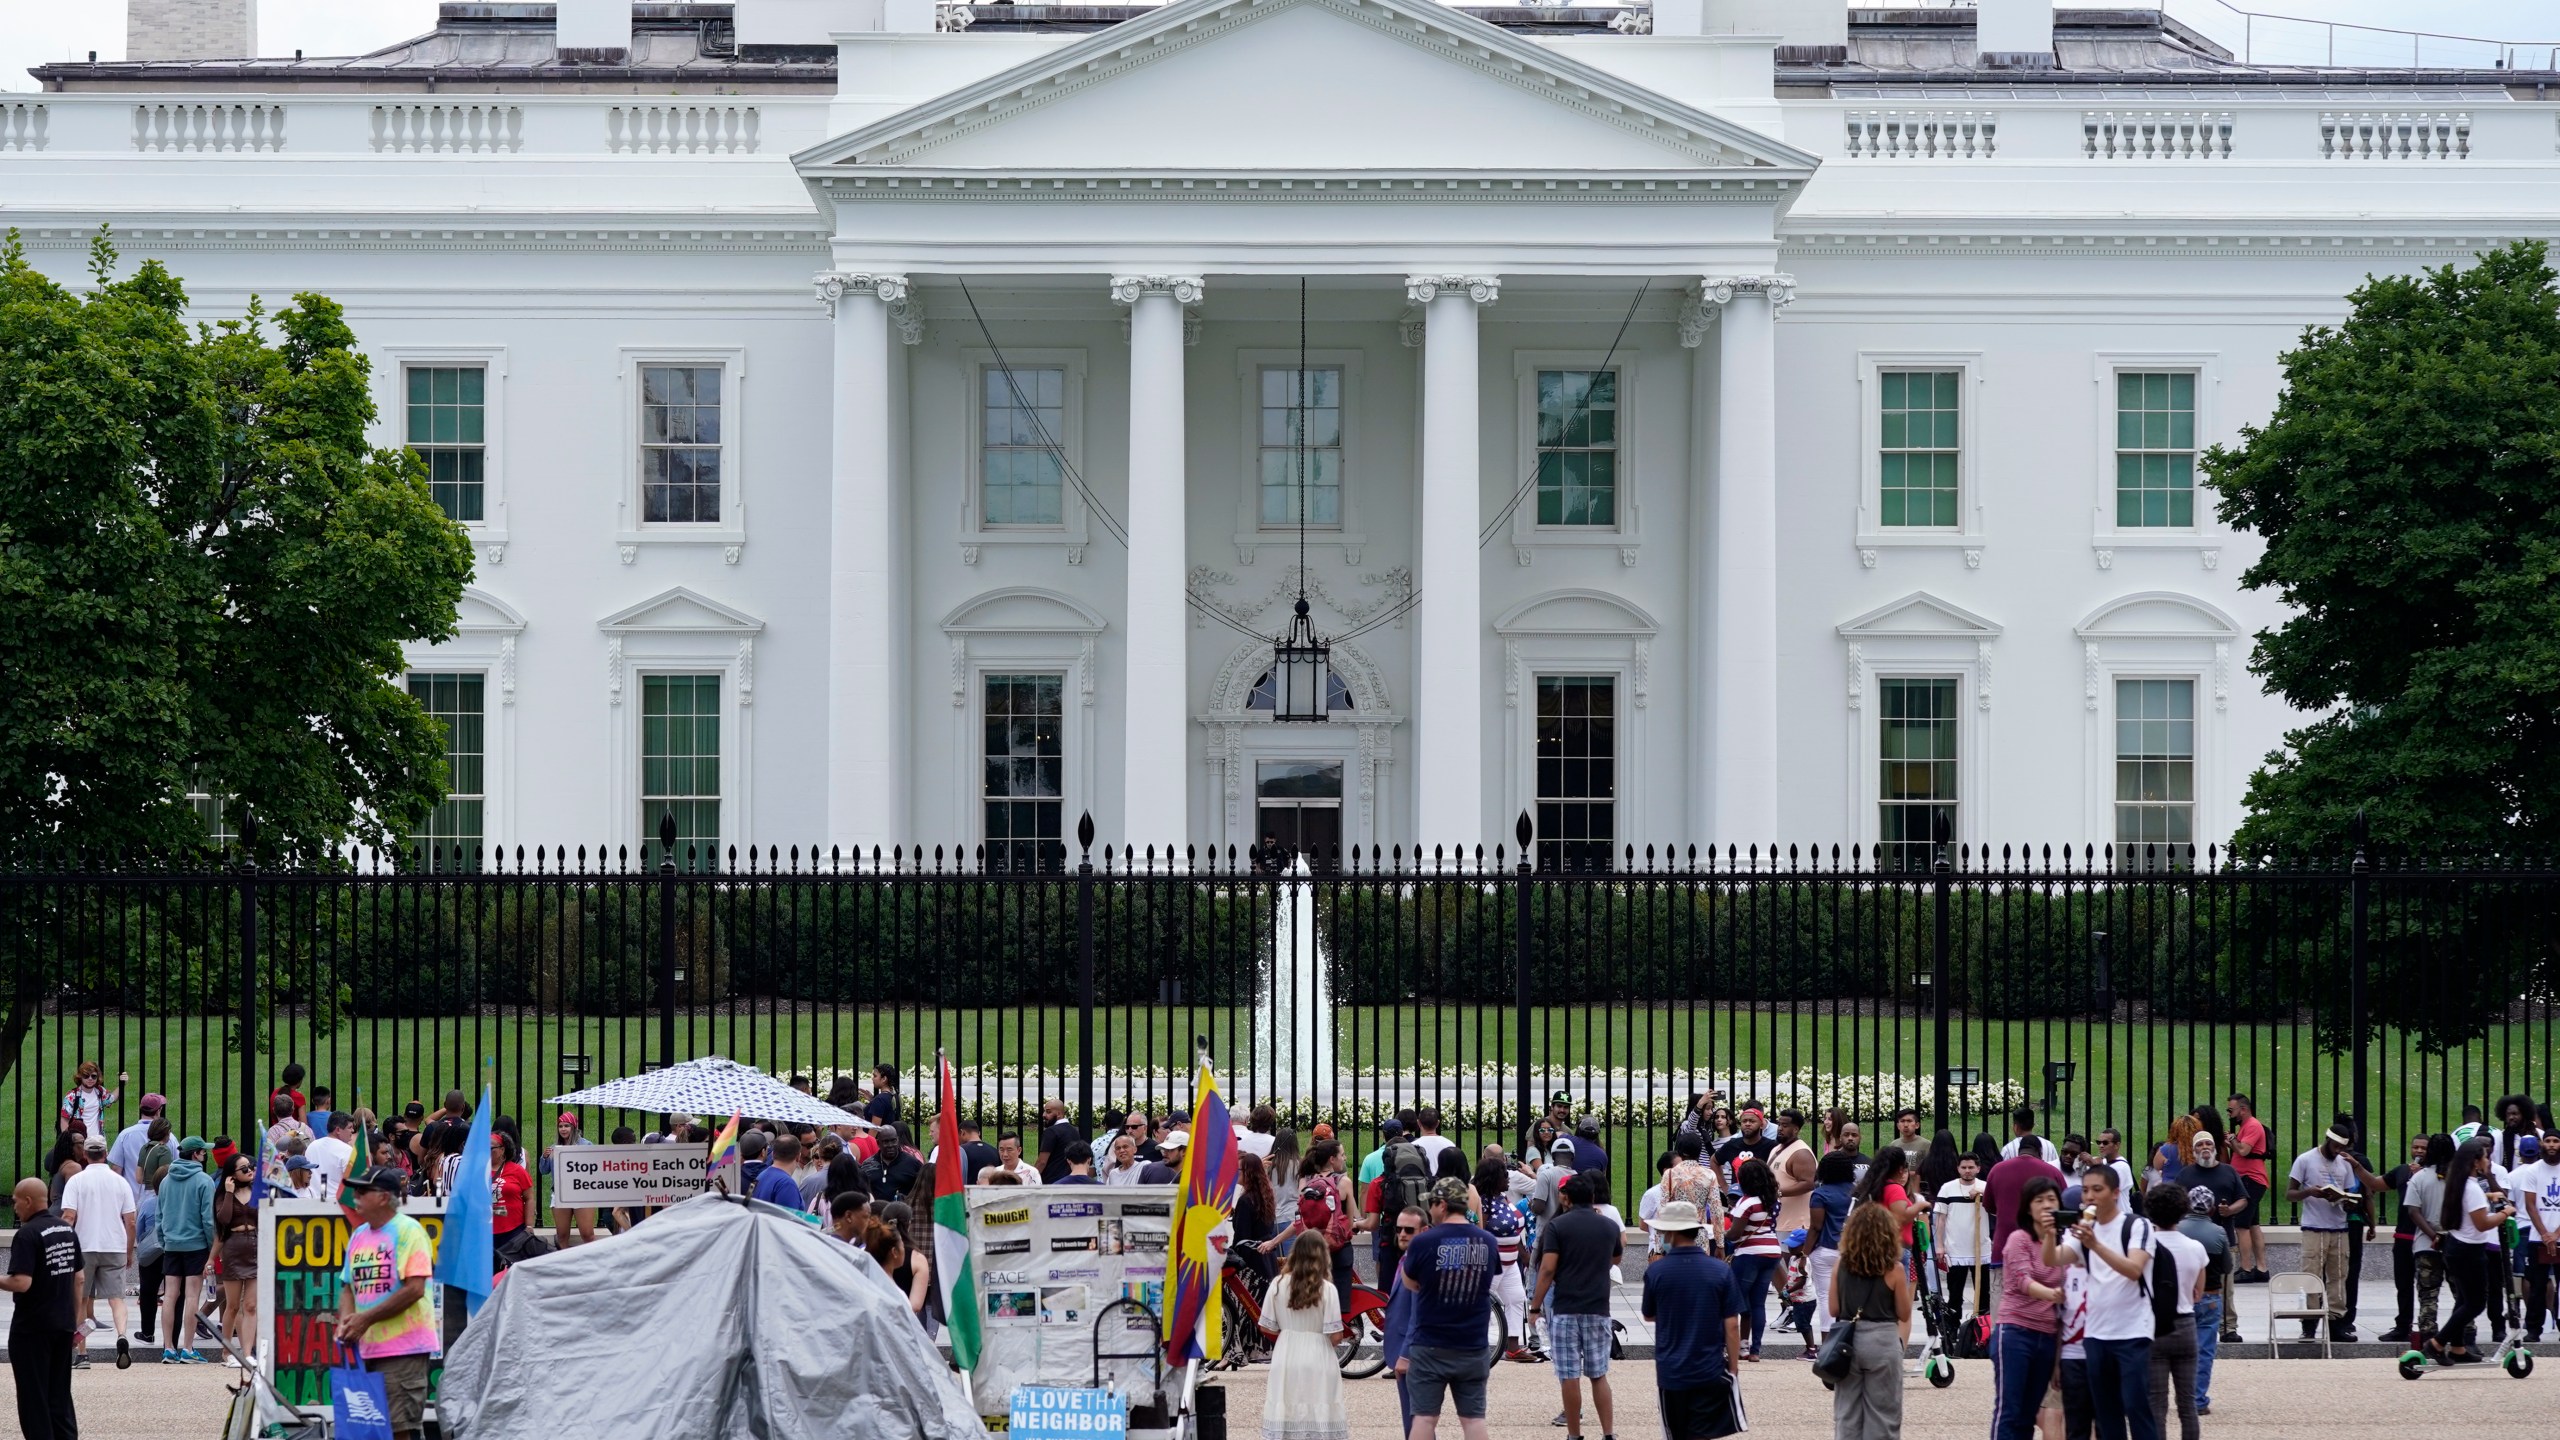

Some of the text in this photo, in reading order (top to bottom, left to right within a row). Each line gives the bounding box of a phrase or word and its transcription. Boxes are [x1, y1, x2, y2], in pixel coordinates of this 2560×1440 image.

[566, 1161, 598, 1175] Stop
[602, 1159, 648, 1174] Hating
[653, 1159, 684, 1171] Each
[573, 1176, 716, 1190] Because You Disagre
[984, 1209, 1029, 1225] ENOUGH!
[354, 1250, 392, 1263] BLACK
[1436, 1244, 1489, 1265] STAND
[353, 1266, 391, 1281] LIVES
[983, 1271, 1026, 1284] PEACE
[1013, 1411, 1122, 1431] NEIGHBOR
